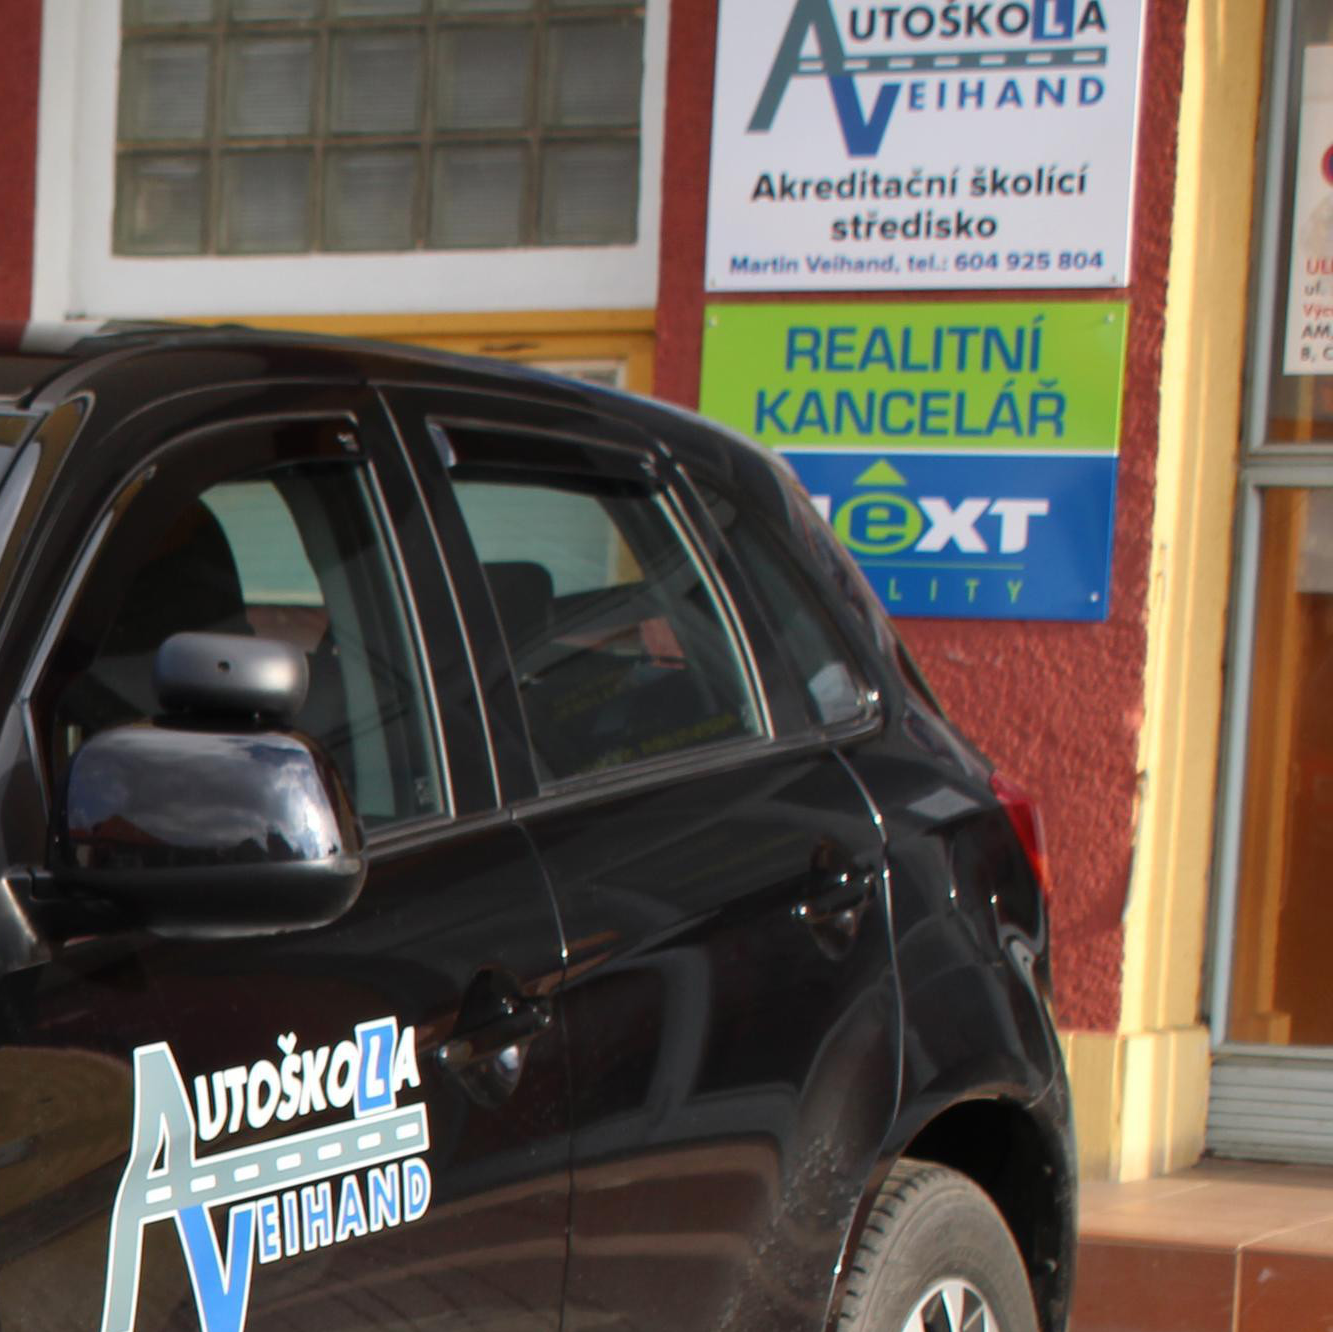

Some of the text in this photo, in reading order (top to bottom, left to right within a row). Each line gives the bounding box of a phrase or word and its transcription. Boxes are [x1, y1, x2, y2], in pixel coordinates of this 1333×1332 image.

[828, 75, 1106, 158] VEIHAND
[751, 163, 1089, 202] Akreditační školící
[830, 210, 998, 241] středisko
[729, 251, 1104, 275] Martin Veihand, tel.: 604 925 804
[785, 314, 1044, 372] REALITNÍ
[754, 379, 1068, 437] KANCELÁŘ
[810, 492, 1049, 554] eXT
[888, 579, 1023, 602] LITY
